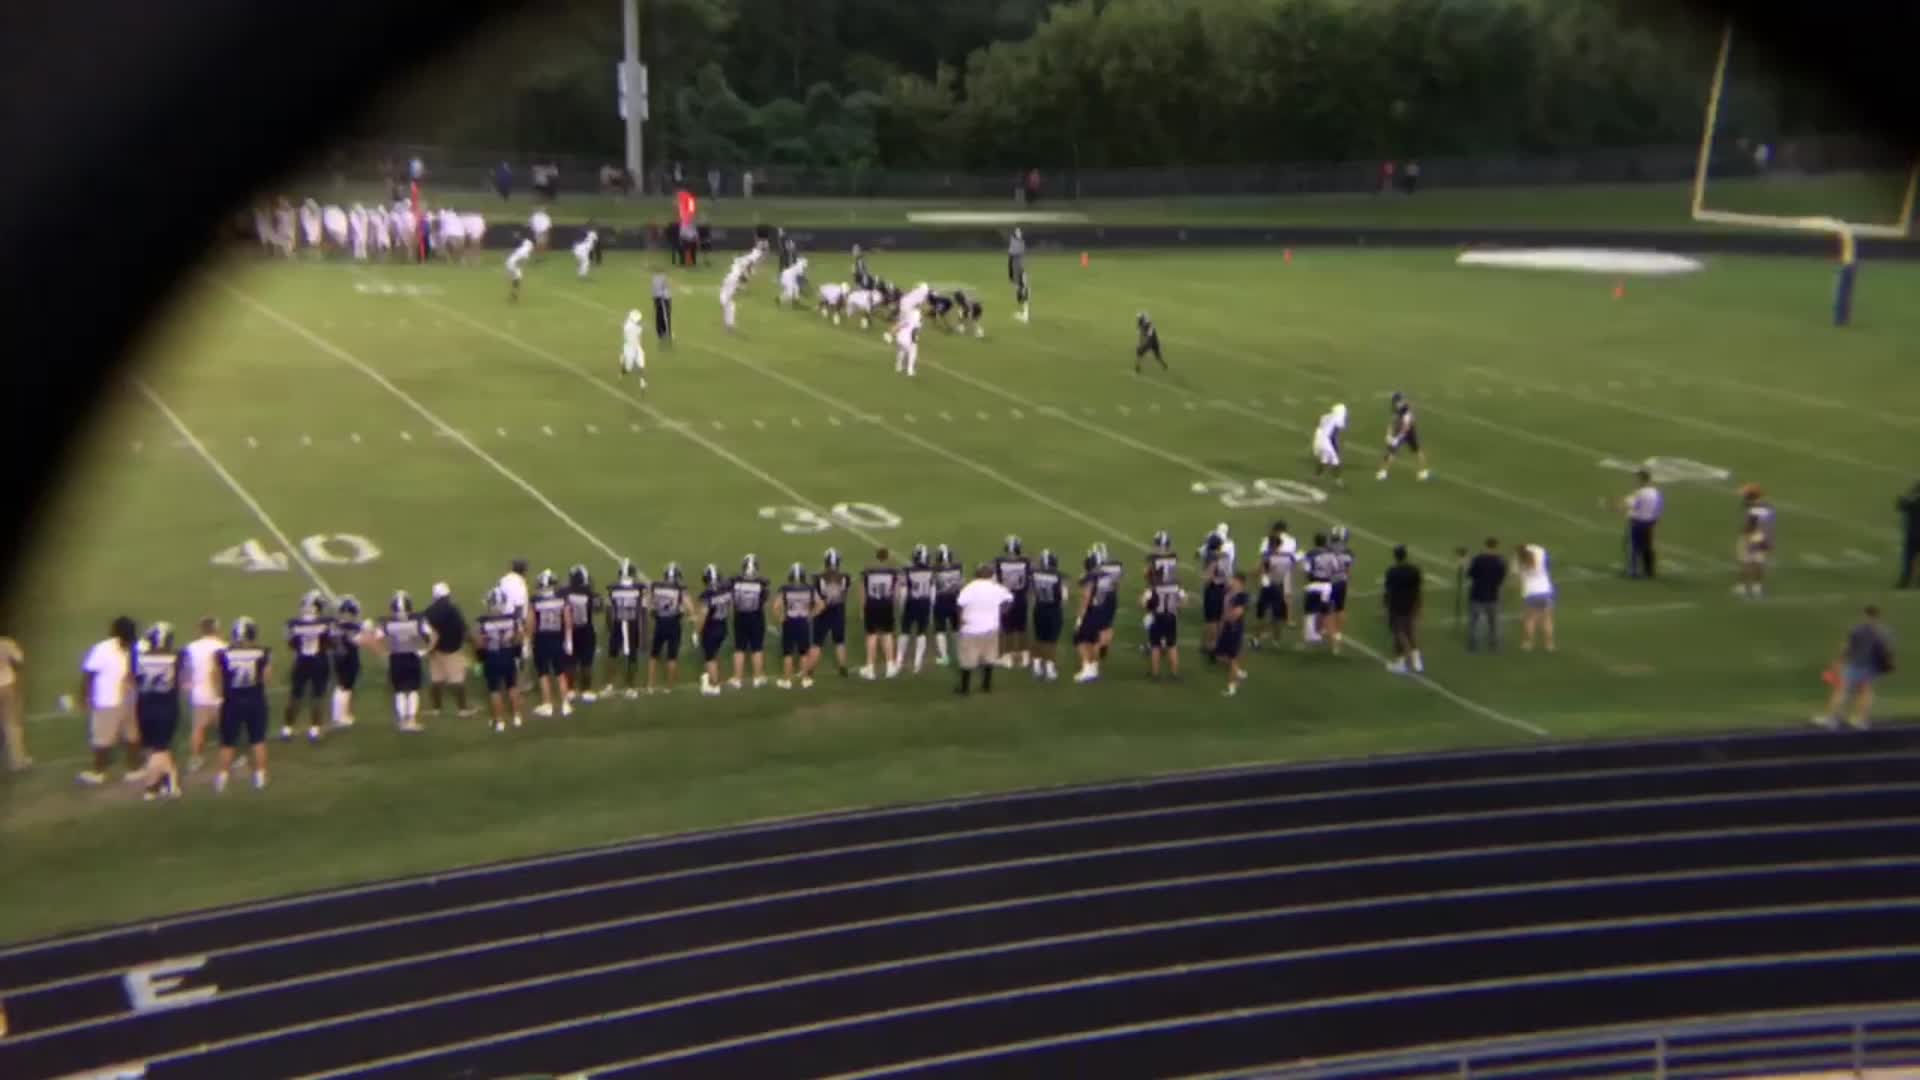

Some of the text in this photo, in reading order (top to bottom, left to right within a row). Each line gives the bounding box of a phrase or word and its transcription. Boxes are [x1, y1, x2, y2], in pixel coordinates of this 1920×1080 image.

[1191, 478, 1328, 508] 20
[758, 502, 903, 533] 30
[211, 533, 382, 571] 40
